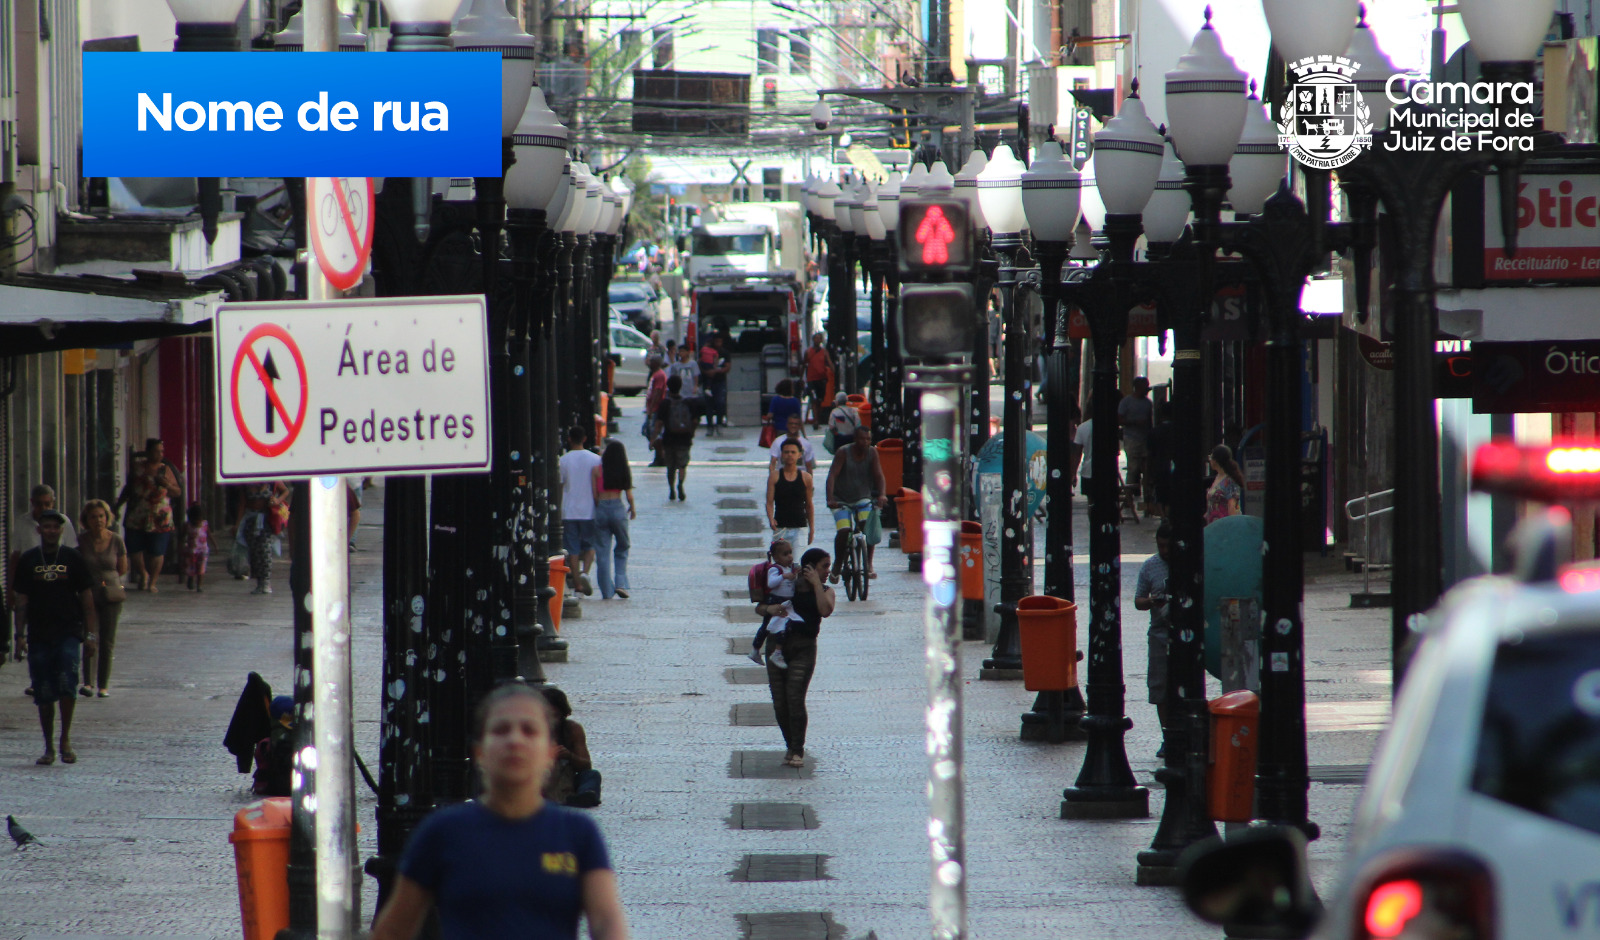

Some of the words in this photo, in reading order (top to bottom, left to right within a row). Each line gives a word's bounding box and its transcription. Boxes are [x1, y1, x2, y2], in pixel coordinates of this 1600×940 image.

[1517, 180, 1600, 229] ótic
[1494, 255, 1569, 271] Receituário
[337, 323, 410, 377] Área
[422, 338, 455, 374] de
[320, 407, 474, 445] Pedestres
[34, 564, 68, 573] GUCCI
